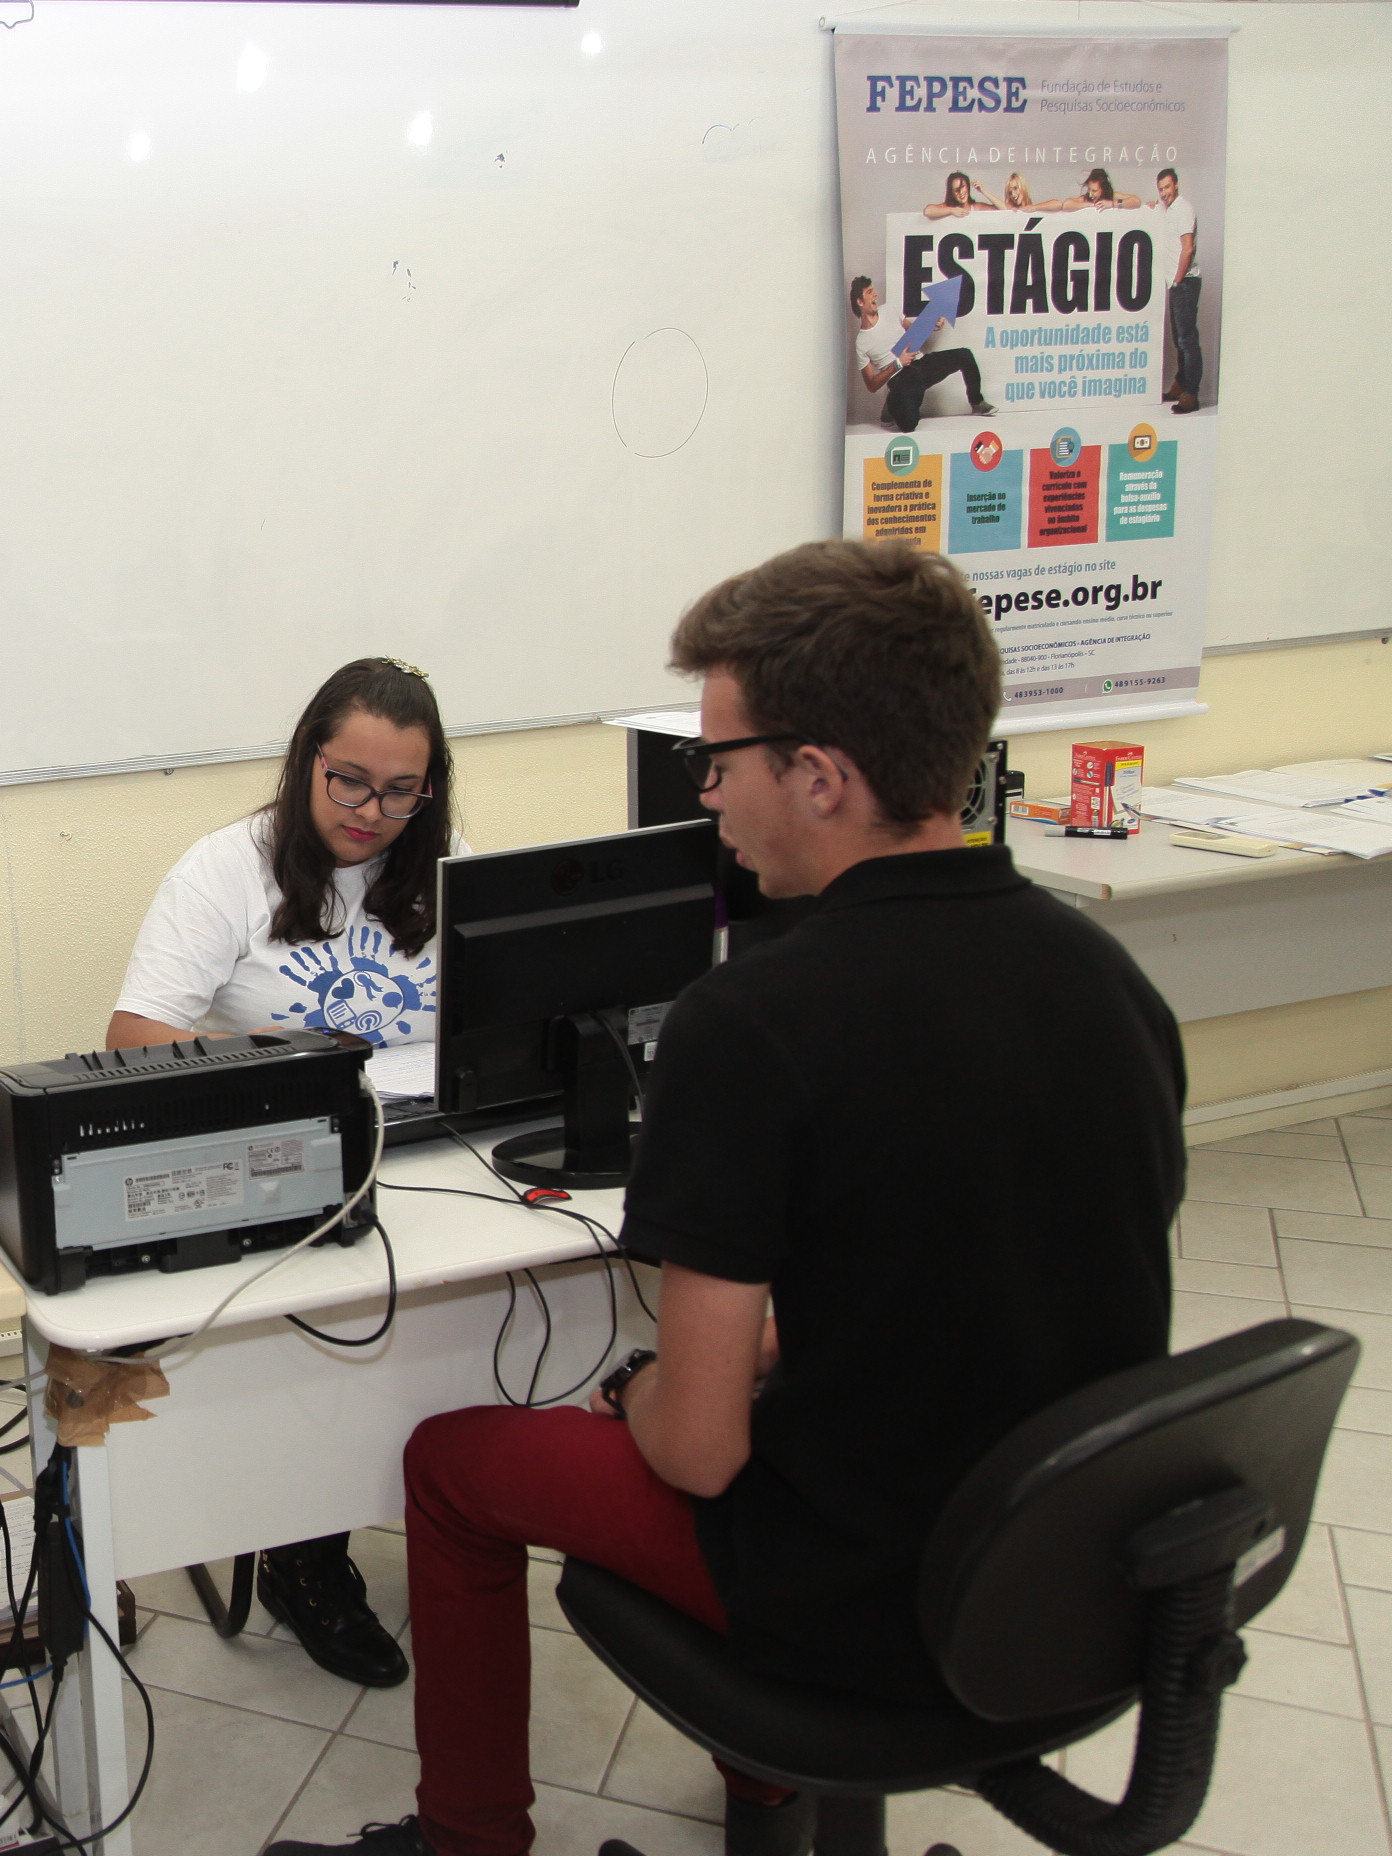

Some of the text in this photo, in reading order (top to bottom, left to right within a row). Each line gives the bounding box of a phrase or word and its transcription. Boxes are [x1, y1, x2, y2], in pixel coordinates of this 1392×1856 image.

[866, 75, 1028, 113] FEPESE
[1040, 79, 1163, 96] Fundação de Estudos e
[1040, 98, 1093, 114] Pesquisas
[866, 143, 1178, 166] AGÊNCIA DE INTEGRAÇÃO
[902, 217, 1154, 319] ESTÁGIO
[984, 320, 1150, 350] A oportunidade está
[1014, 347, 1148, 374] mais próxima do
[1004, 374, 1147, 403] que você imagina
[1119, 470, 1163, 481] Remuneração
[871, 479, 933, 491] Complementa de
[1125, 482, 1148, 491] através
[873, 493, 894, 503] forma
[895, 491, 924, 501] criativa
[966, 492, 1006, 503] Inserção no
[867, 504, 902, 514] inovadora
[909, 502, 936, 512] prática
[966, 503, 1006, 514] mercado de
[866, 513, 936, 526] dos conhecimentos
[971, 515, 1000, 525] trabalho
[875, 525, 926, 537] adquiridos em
[972, 570, 1004, 581] nossas
[1006, 568, 1032, 580] vagas
[1034, 564, 1046, 576] de
[1047, 562, 1082, 576] estágio
[1084, 562, 1096, 572] no
[1098, 559, 1116, 571] site
[969, 574, 1162, 621] epese.org.br
[1021, 640, 1077, 652] SOCIOECONÔMICOS
[1080, 638, 1106, 646] AGÊNCIA
[1115, 633, 1151, 643] INTEGRAÇÃO
[1050, 651, 1084, 660] Florianópolis
[1014, 687, 1064, 698] 483953-1000
